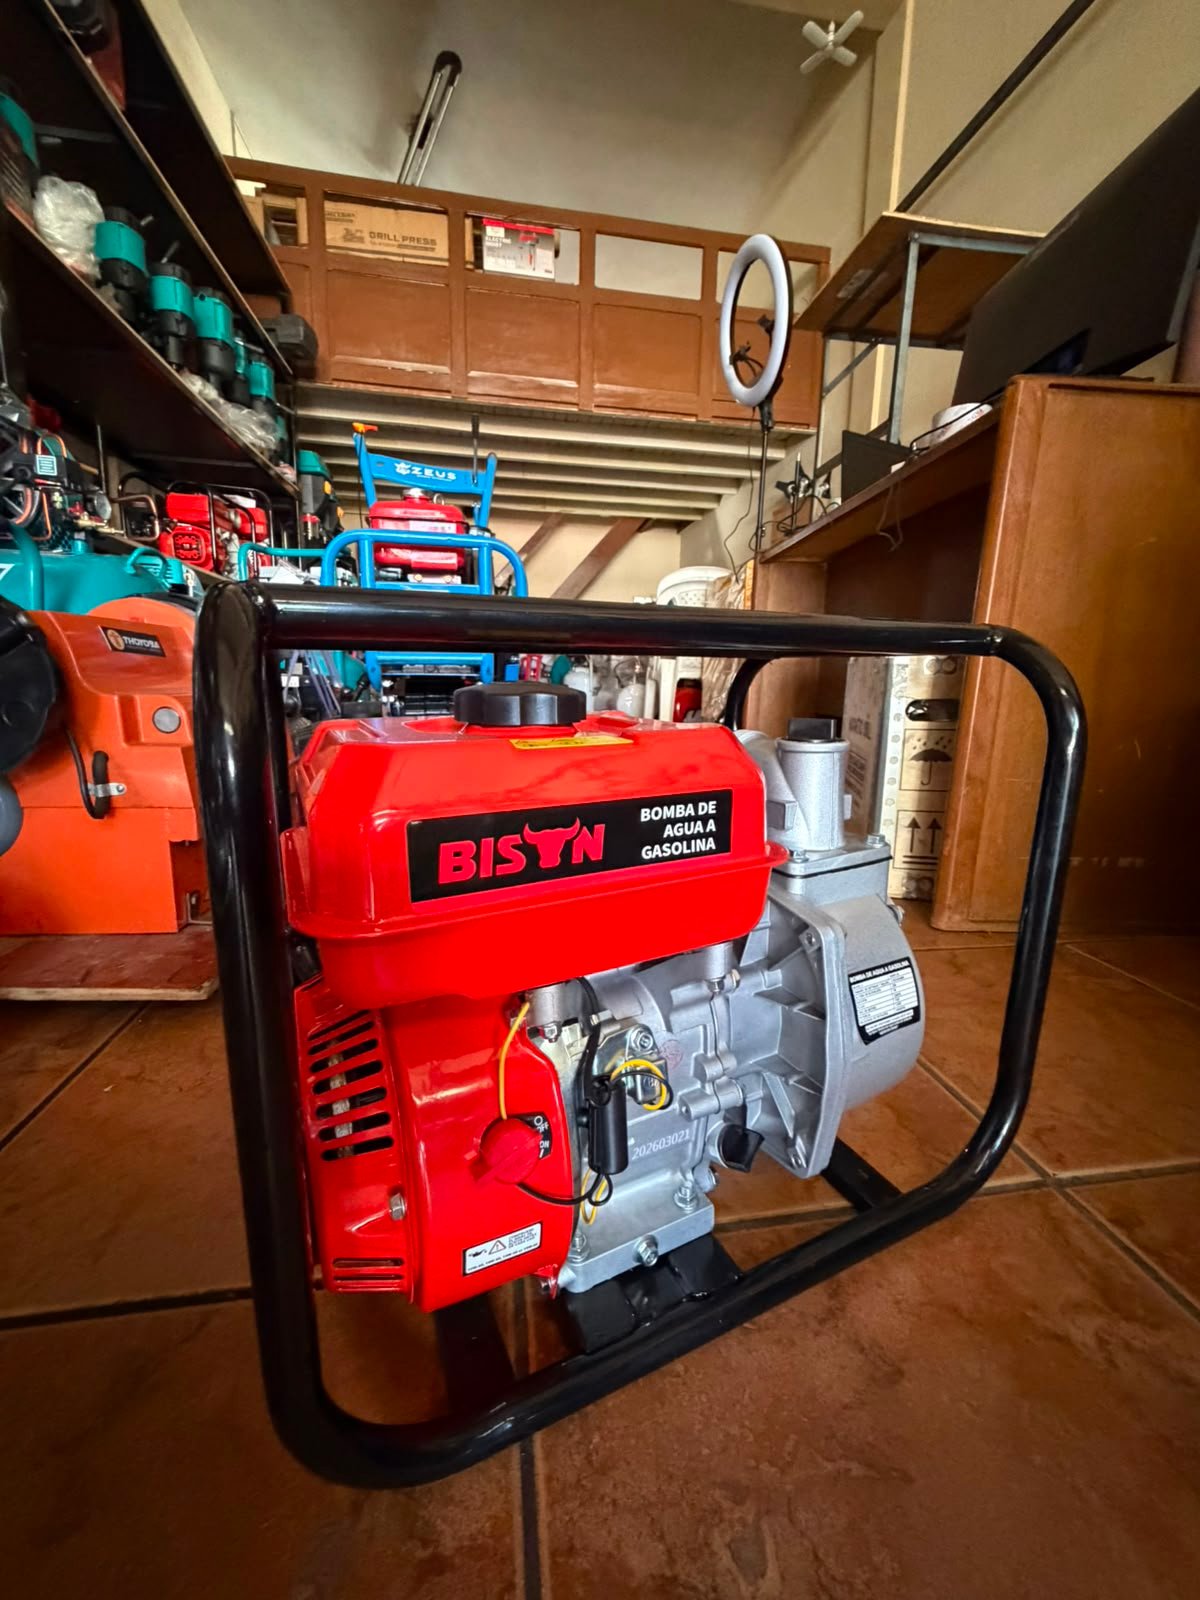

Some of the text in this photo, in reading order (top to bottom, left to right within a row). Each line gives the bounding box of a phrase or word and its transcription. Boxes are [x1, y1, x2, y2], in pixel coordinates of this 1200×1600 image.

[369, 231, 400, 243] DRILL
[401, 235, 437, 247] PRESS
[411, 467, 457, 480] ZEUS
[640, 800, 717, 823] BOMBA DE
[663, 821, 716, 838] AGUA A
[641, 837, 716, 860] GASOLINA
[631, 1128, 690, 1161] 202603021
